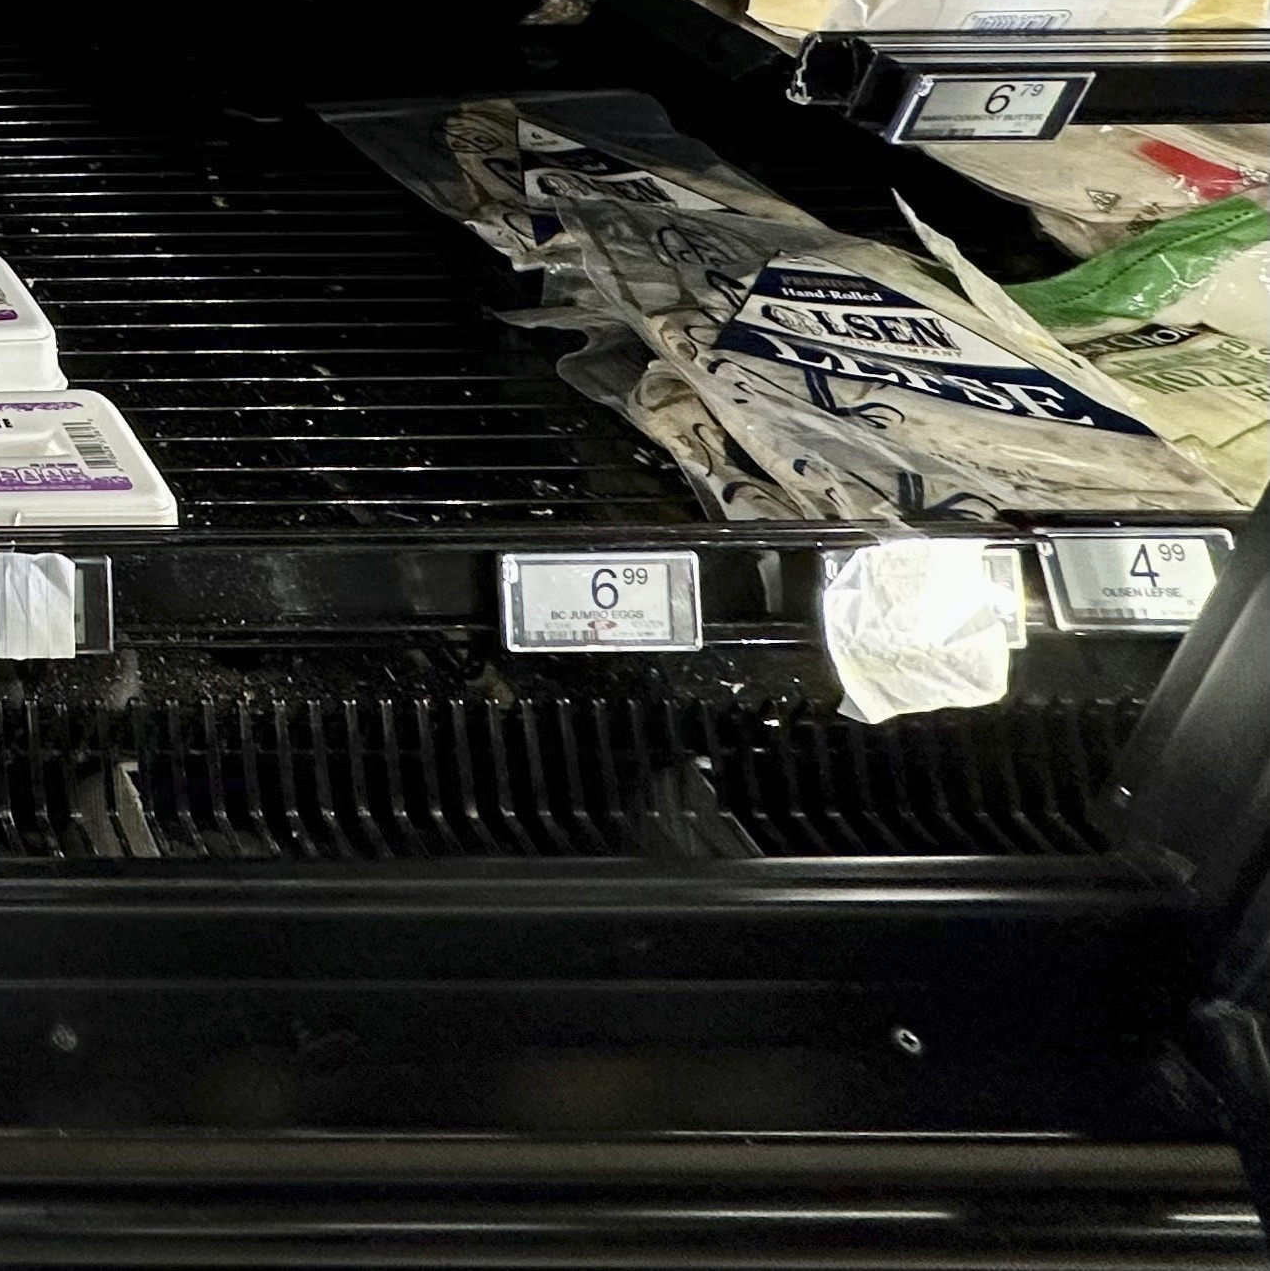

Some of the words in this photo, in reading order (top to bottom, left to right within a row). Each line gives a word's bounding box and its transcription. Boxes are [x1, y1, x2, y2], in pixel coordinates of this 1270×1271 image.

[984, 84, 1016, 115] 6
[1019, 83, 1045, 97] 79
[781, 286, 883, 302] Hand-Rolled
[883, 340, 962, 358] COMPANY
[1129, 543, 1160, 588] 4
[591, 568, 619, 610] 6
[621, 567, 648, 585] 99
[550, 610, 568, 620] BC
[569, 610, 609, 620] JUMBO
